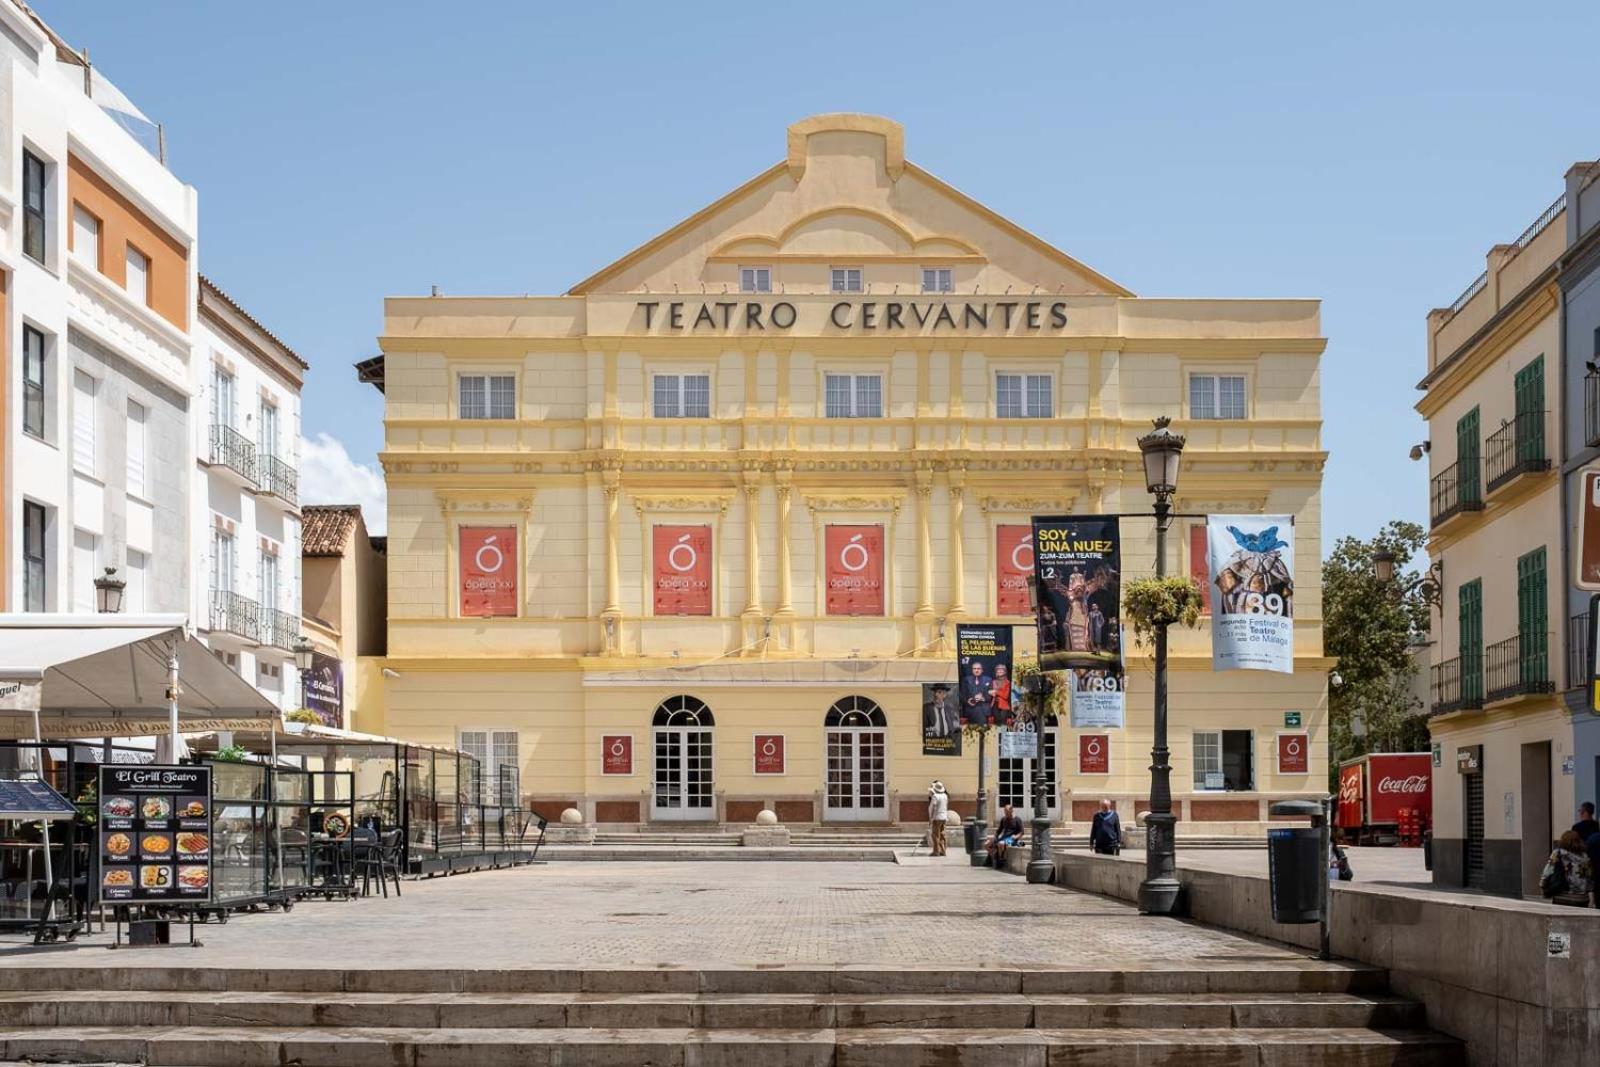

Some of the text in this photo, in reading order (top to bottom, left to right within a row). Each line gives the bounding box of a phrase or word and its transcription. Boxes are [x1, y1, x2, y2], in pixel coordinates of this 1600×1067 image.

[636, 302, 1068, 330] TEATRO CERVANTES
[1038, 529, 1068, 541] SOY
[1039, 540, 1113, 552] UNA NUEZ
[1039, 552, 1103, 560] ZUM-ZUM TEATRE
[1249, 618, 1280, 628] Festival
[1249, 626, 1276, 635] Teatro
[1249, 634, 1260, 642] de
[115, 770, 198, 784] El Grill Teatro
